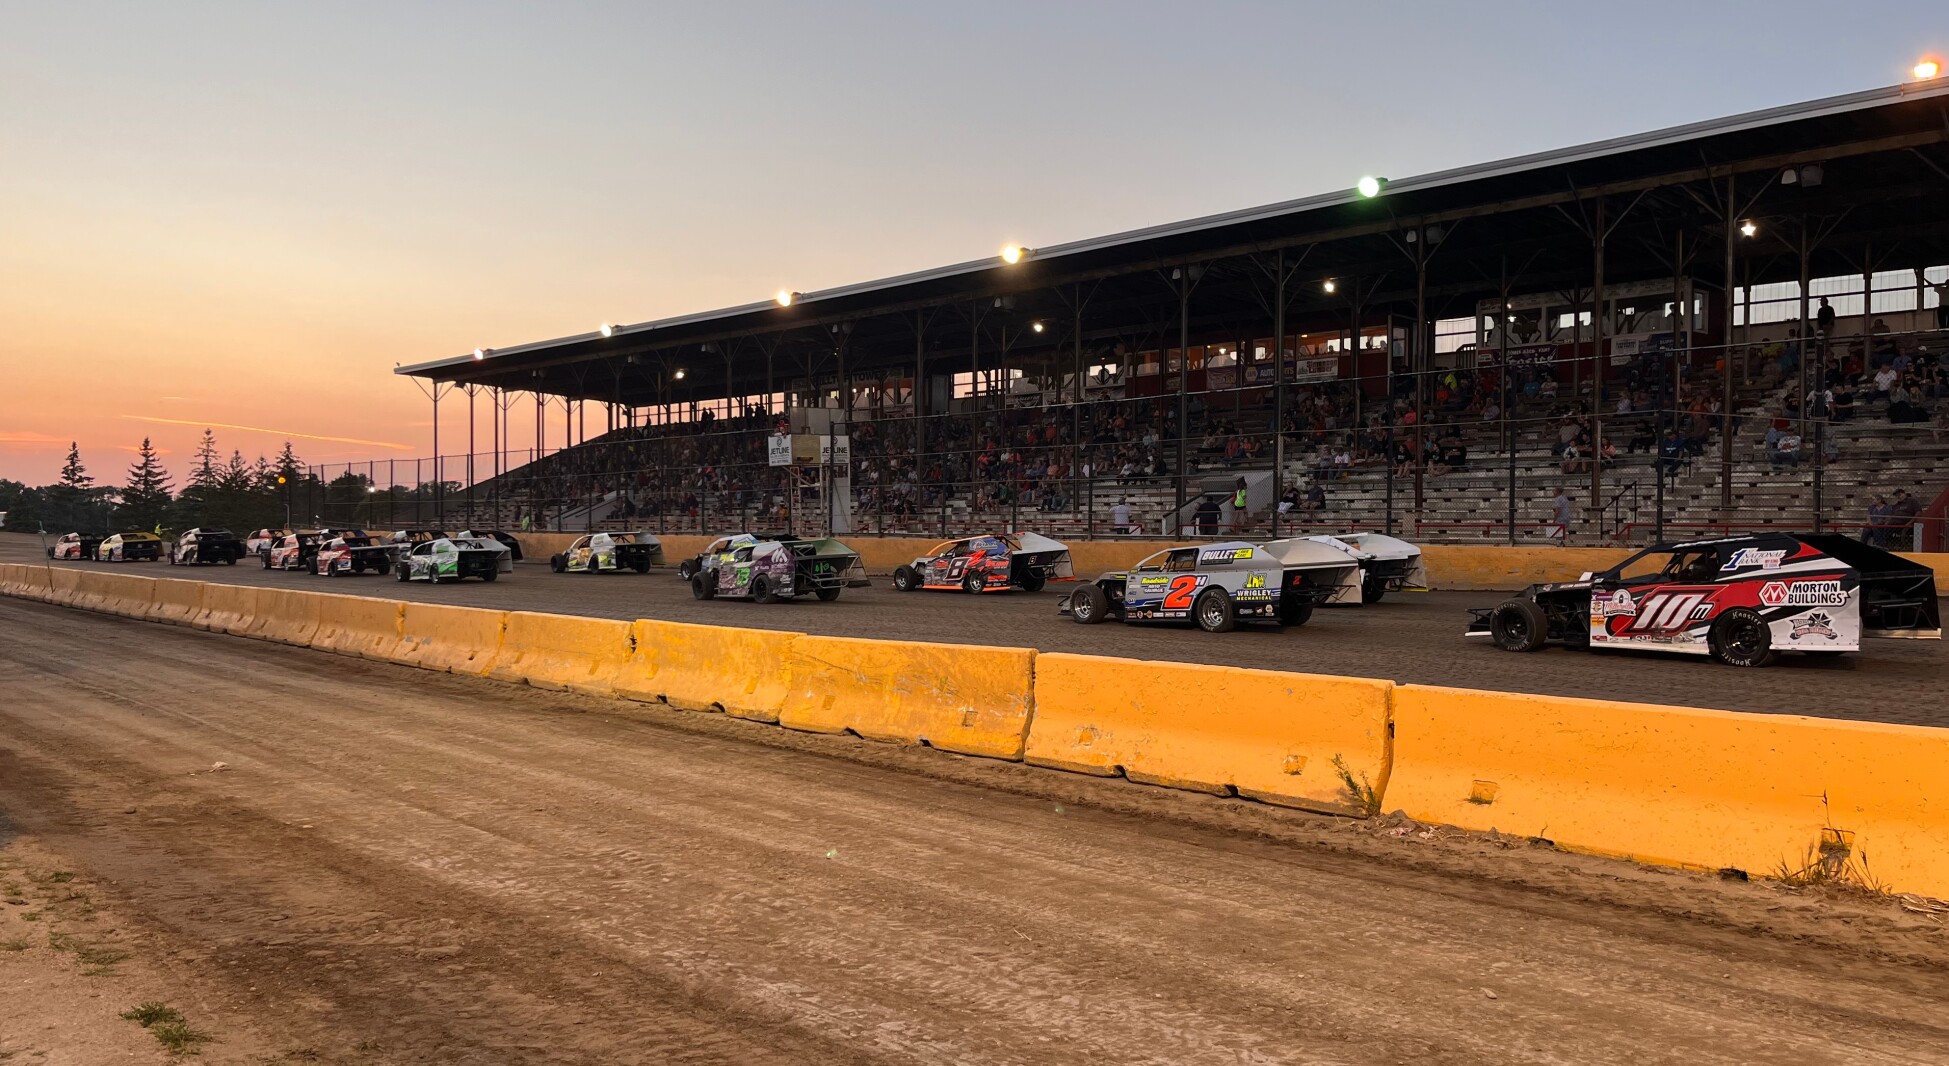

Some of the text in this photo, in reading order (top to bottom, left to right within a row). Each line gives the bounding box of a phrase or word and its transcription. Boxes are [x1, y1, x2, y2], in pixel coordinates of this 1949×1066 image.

[770, 447, 790, 455] JETLINE
[1202, 550, 1236, 560] BULLET
[944, 557, 972, 581] 8
[1163, 575, 1208, 608] 2 H
[1791, 583, 1838, 592] MORTON
[1788, 593, 1842, 603] BUILDINGS
[1632, 593, 1706, 629] 10
[1732, 611, 1762, 625] Hoosier
